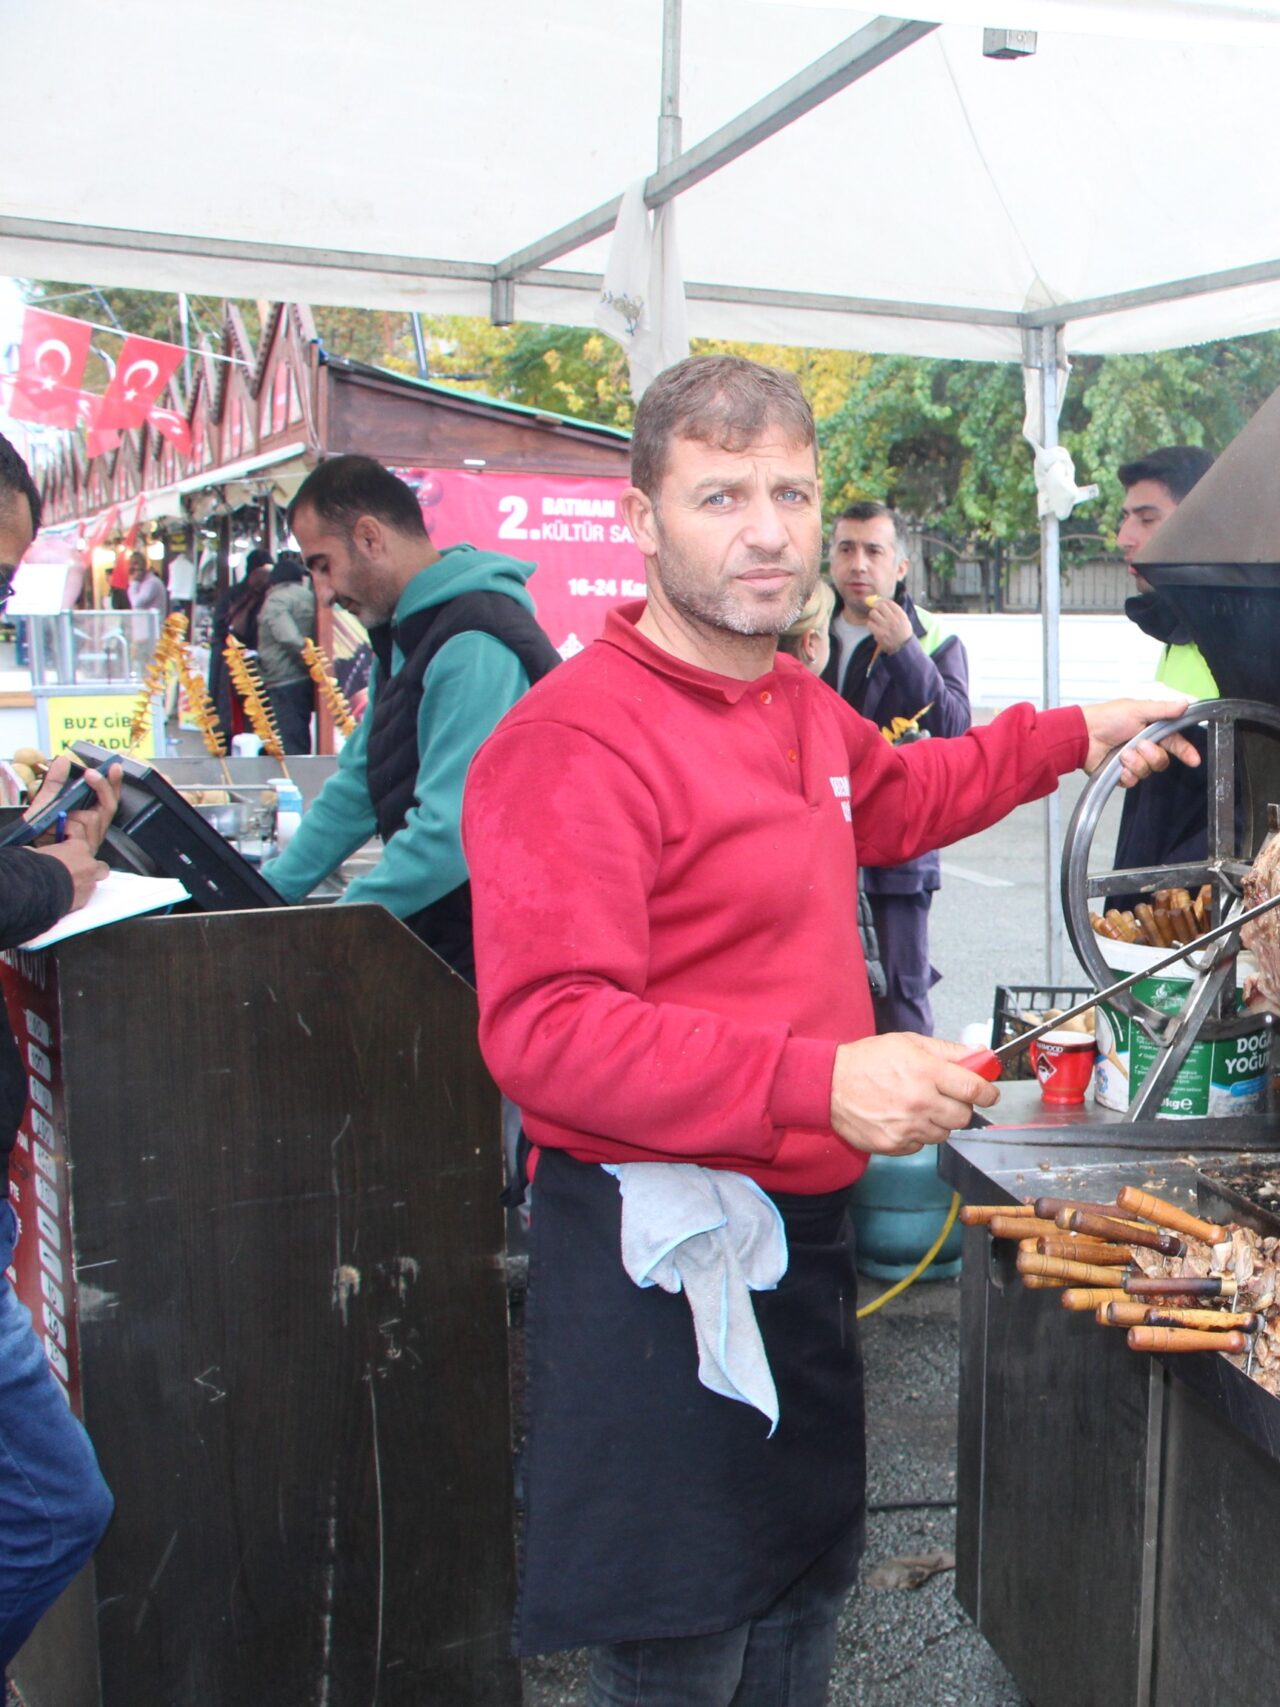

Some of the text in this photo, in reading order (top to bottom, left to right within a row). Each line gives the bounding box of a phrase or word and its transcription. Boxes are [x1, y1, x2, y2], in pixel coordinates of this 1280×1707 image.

[498, 495, 541, 540] 2.
[542, 497, 615, 518] BATMAN
[542, 520, 604, 542] KÜLTÜR
[568, 578, 617, 596] 16-24
[64, 712, 132, 729] BUZ GİB
